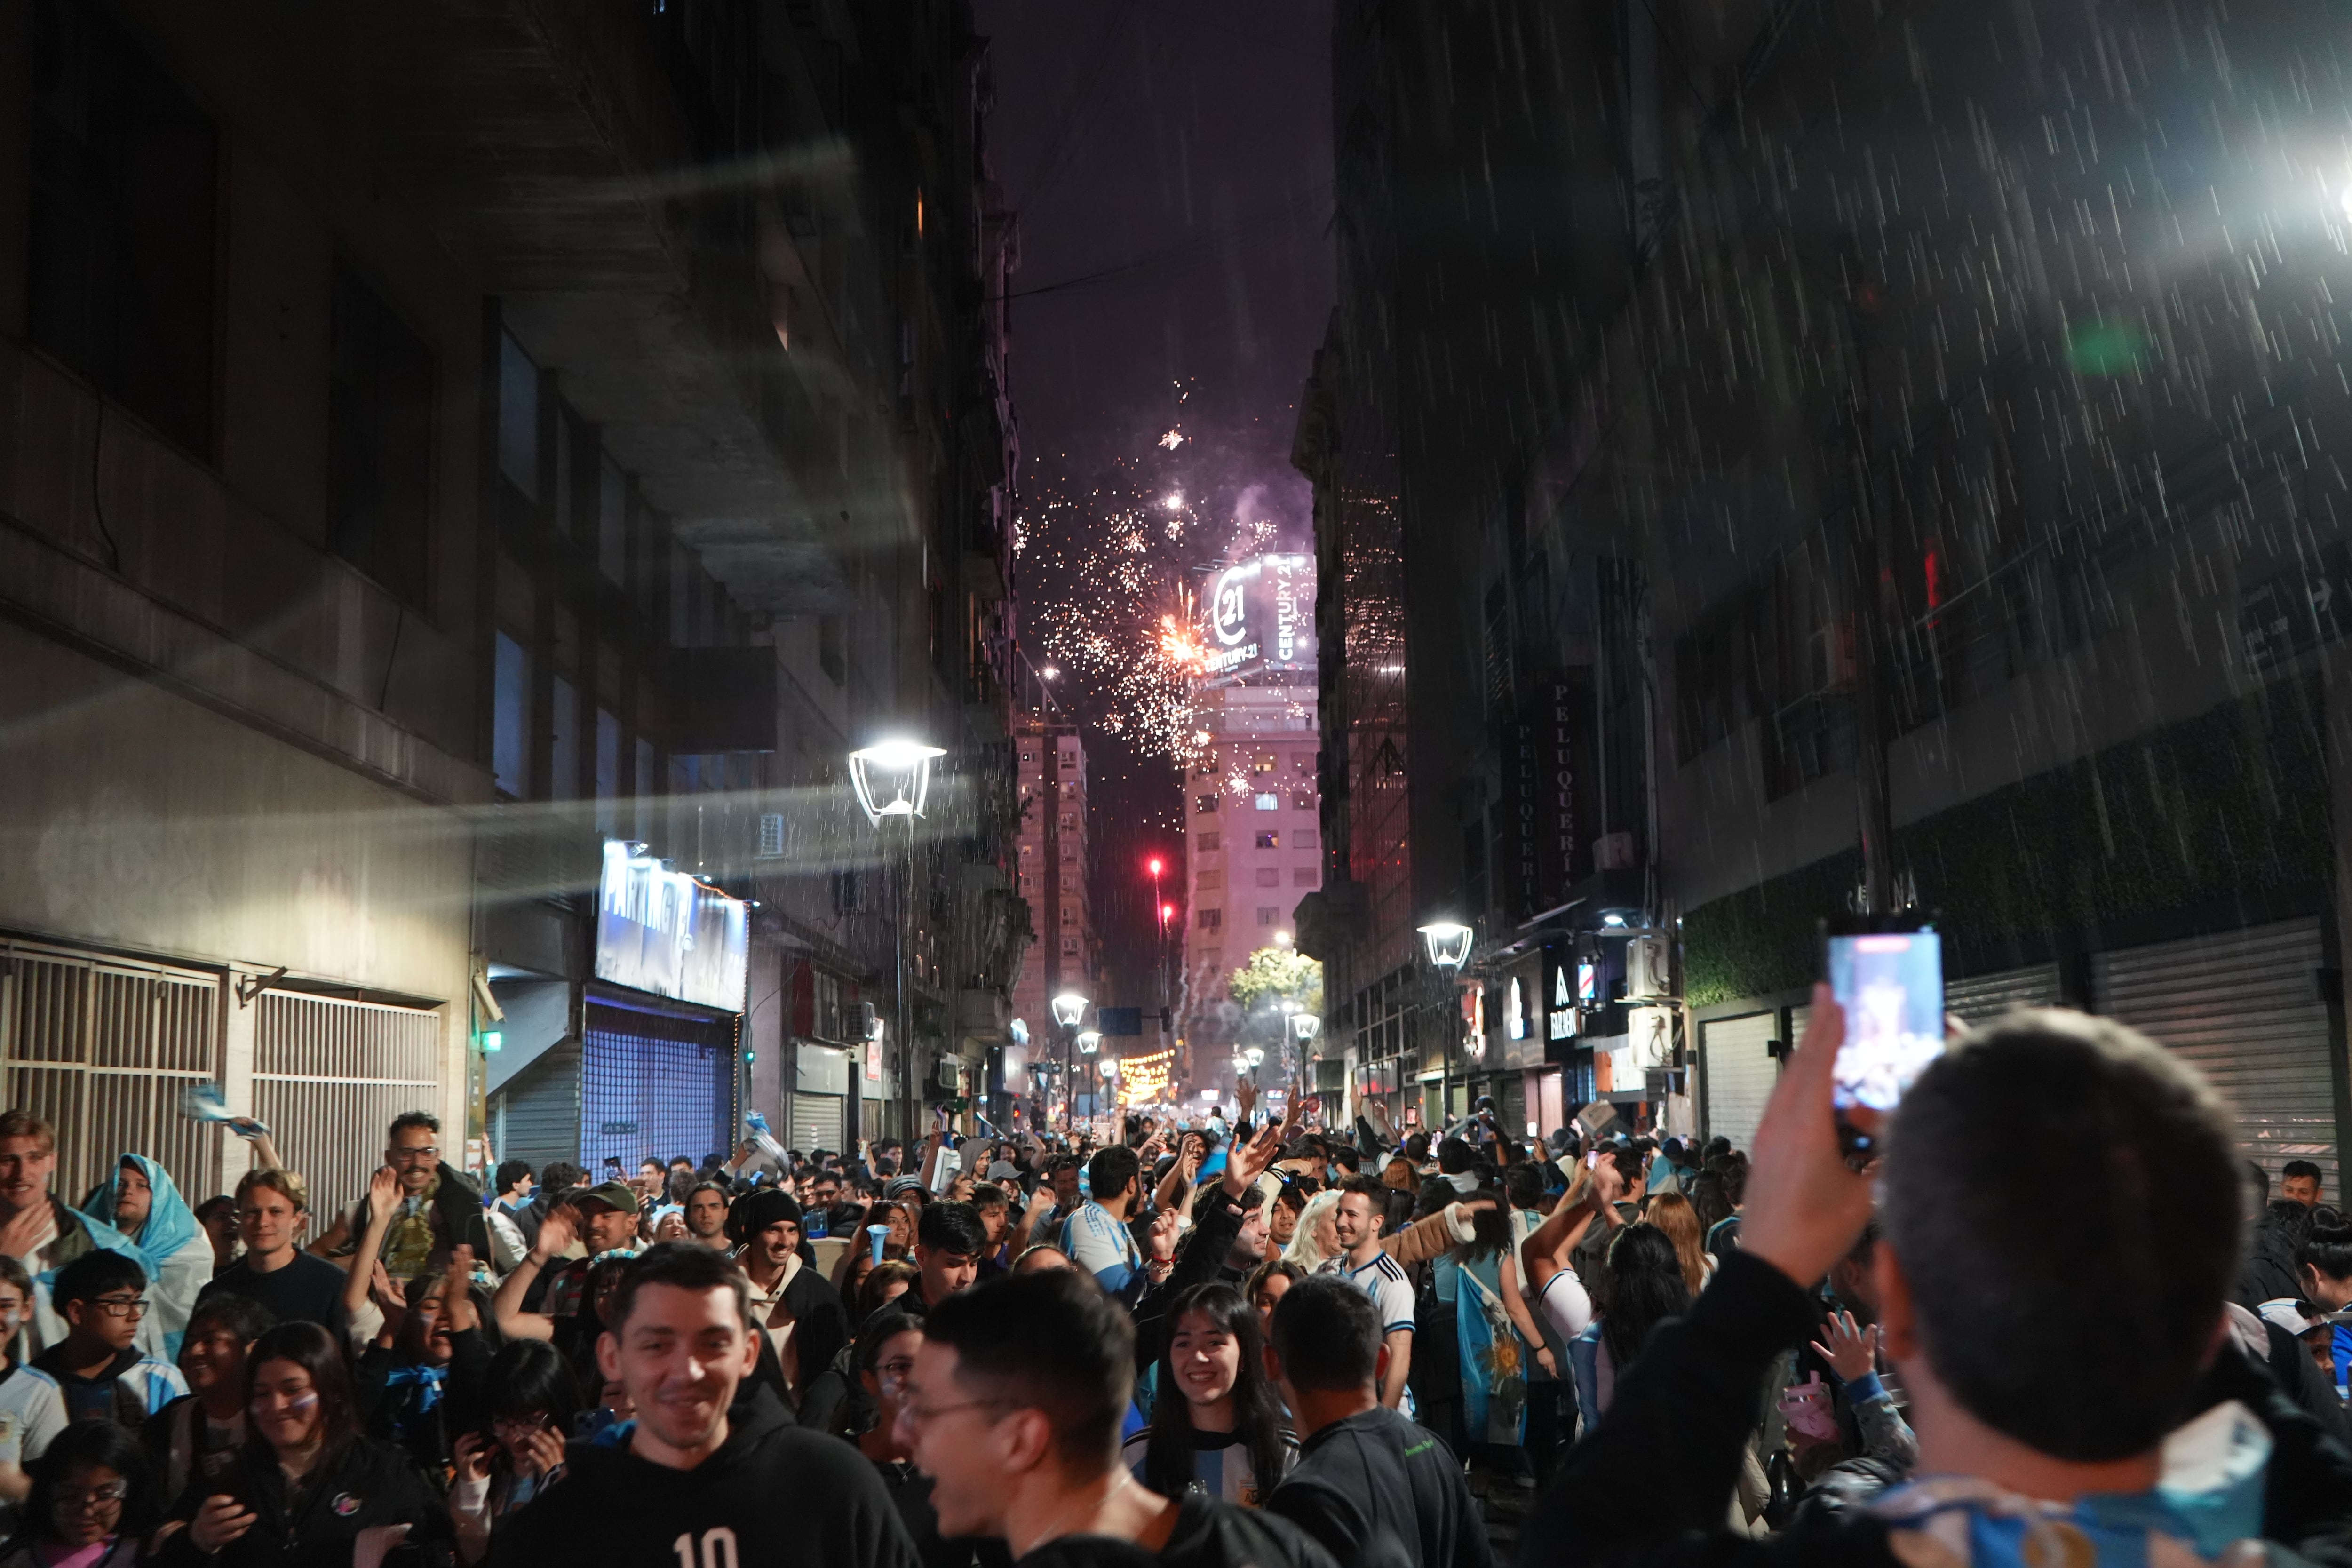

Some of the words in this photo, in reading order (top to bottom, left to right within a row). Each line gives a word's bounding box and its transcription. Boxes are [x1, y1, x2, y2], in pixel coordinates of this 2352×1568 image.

[1277, 557, 1291, 578] 21
[1220, 585, 1245, 626] 21
[1277, 578, 1293, 661] CENTURY
[1204, 646, 1247, 673] CENTURY
[1248, 643, 1258, 659] 21
[604, 858, 672, 935] PARKING
[673, 1526, 740, 1568] 10
